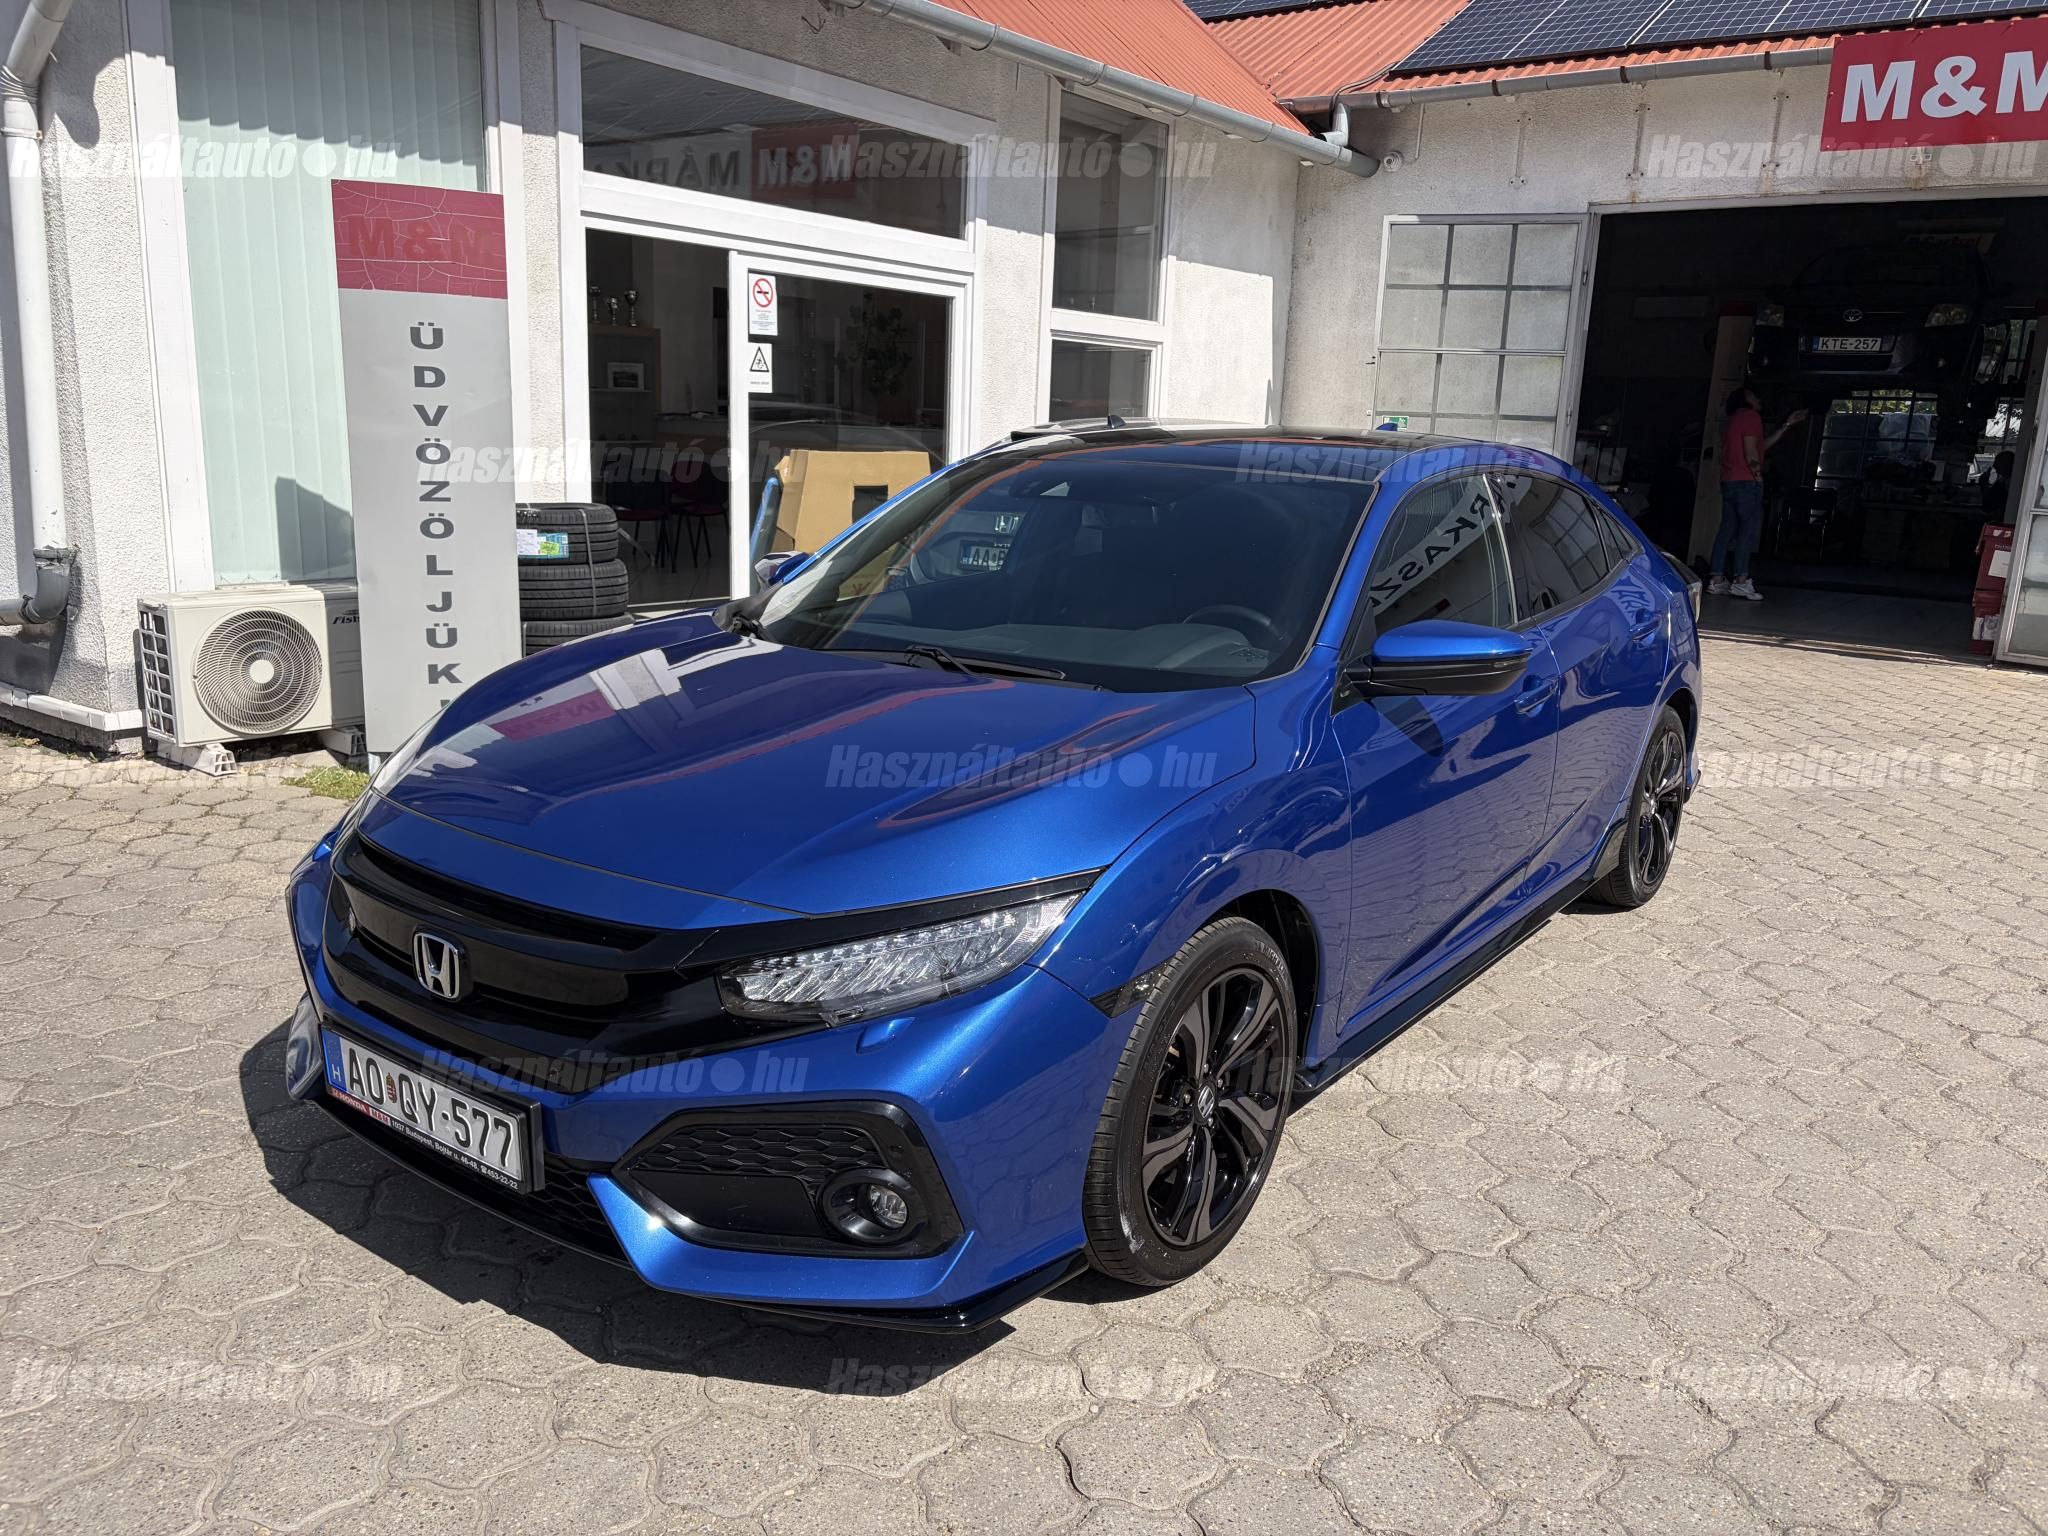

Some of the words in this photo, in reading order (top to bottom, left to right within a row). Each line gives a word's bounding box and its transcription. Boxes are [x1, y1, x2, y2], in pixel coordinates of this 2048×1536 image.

[1841, 50, 2048, 122] M&M
[1821, 338, 1878, 350] KTE-257
[331, 1064, 341, 1079] H
[349, 1047, 385, 1105] AO
[339, 1091, 367, 1112] HONDA
